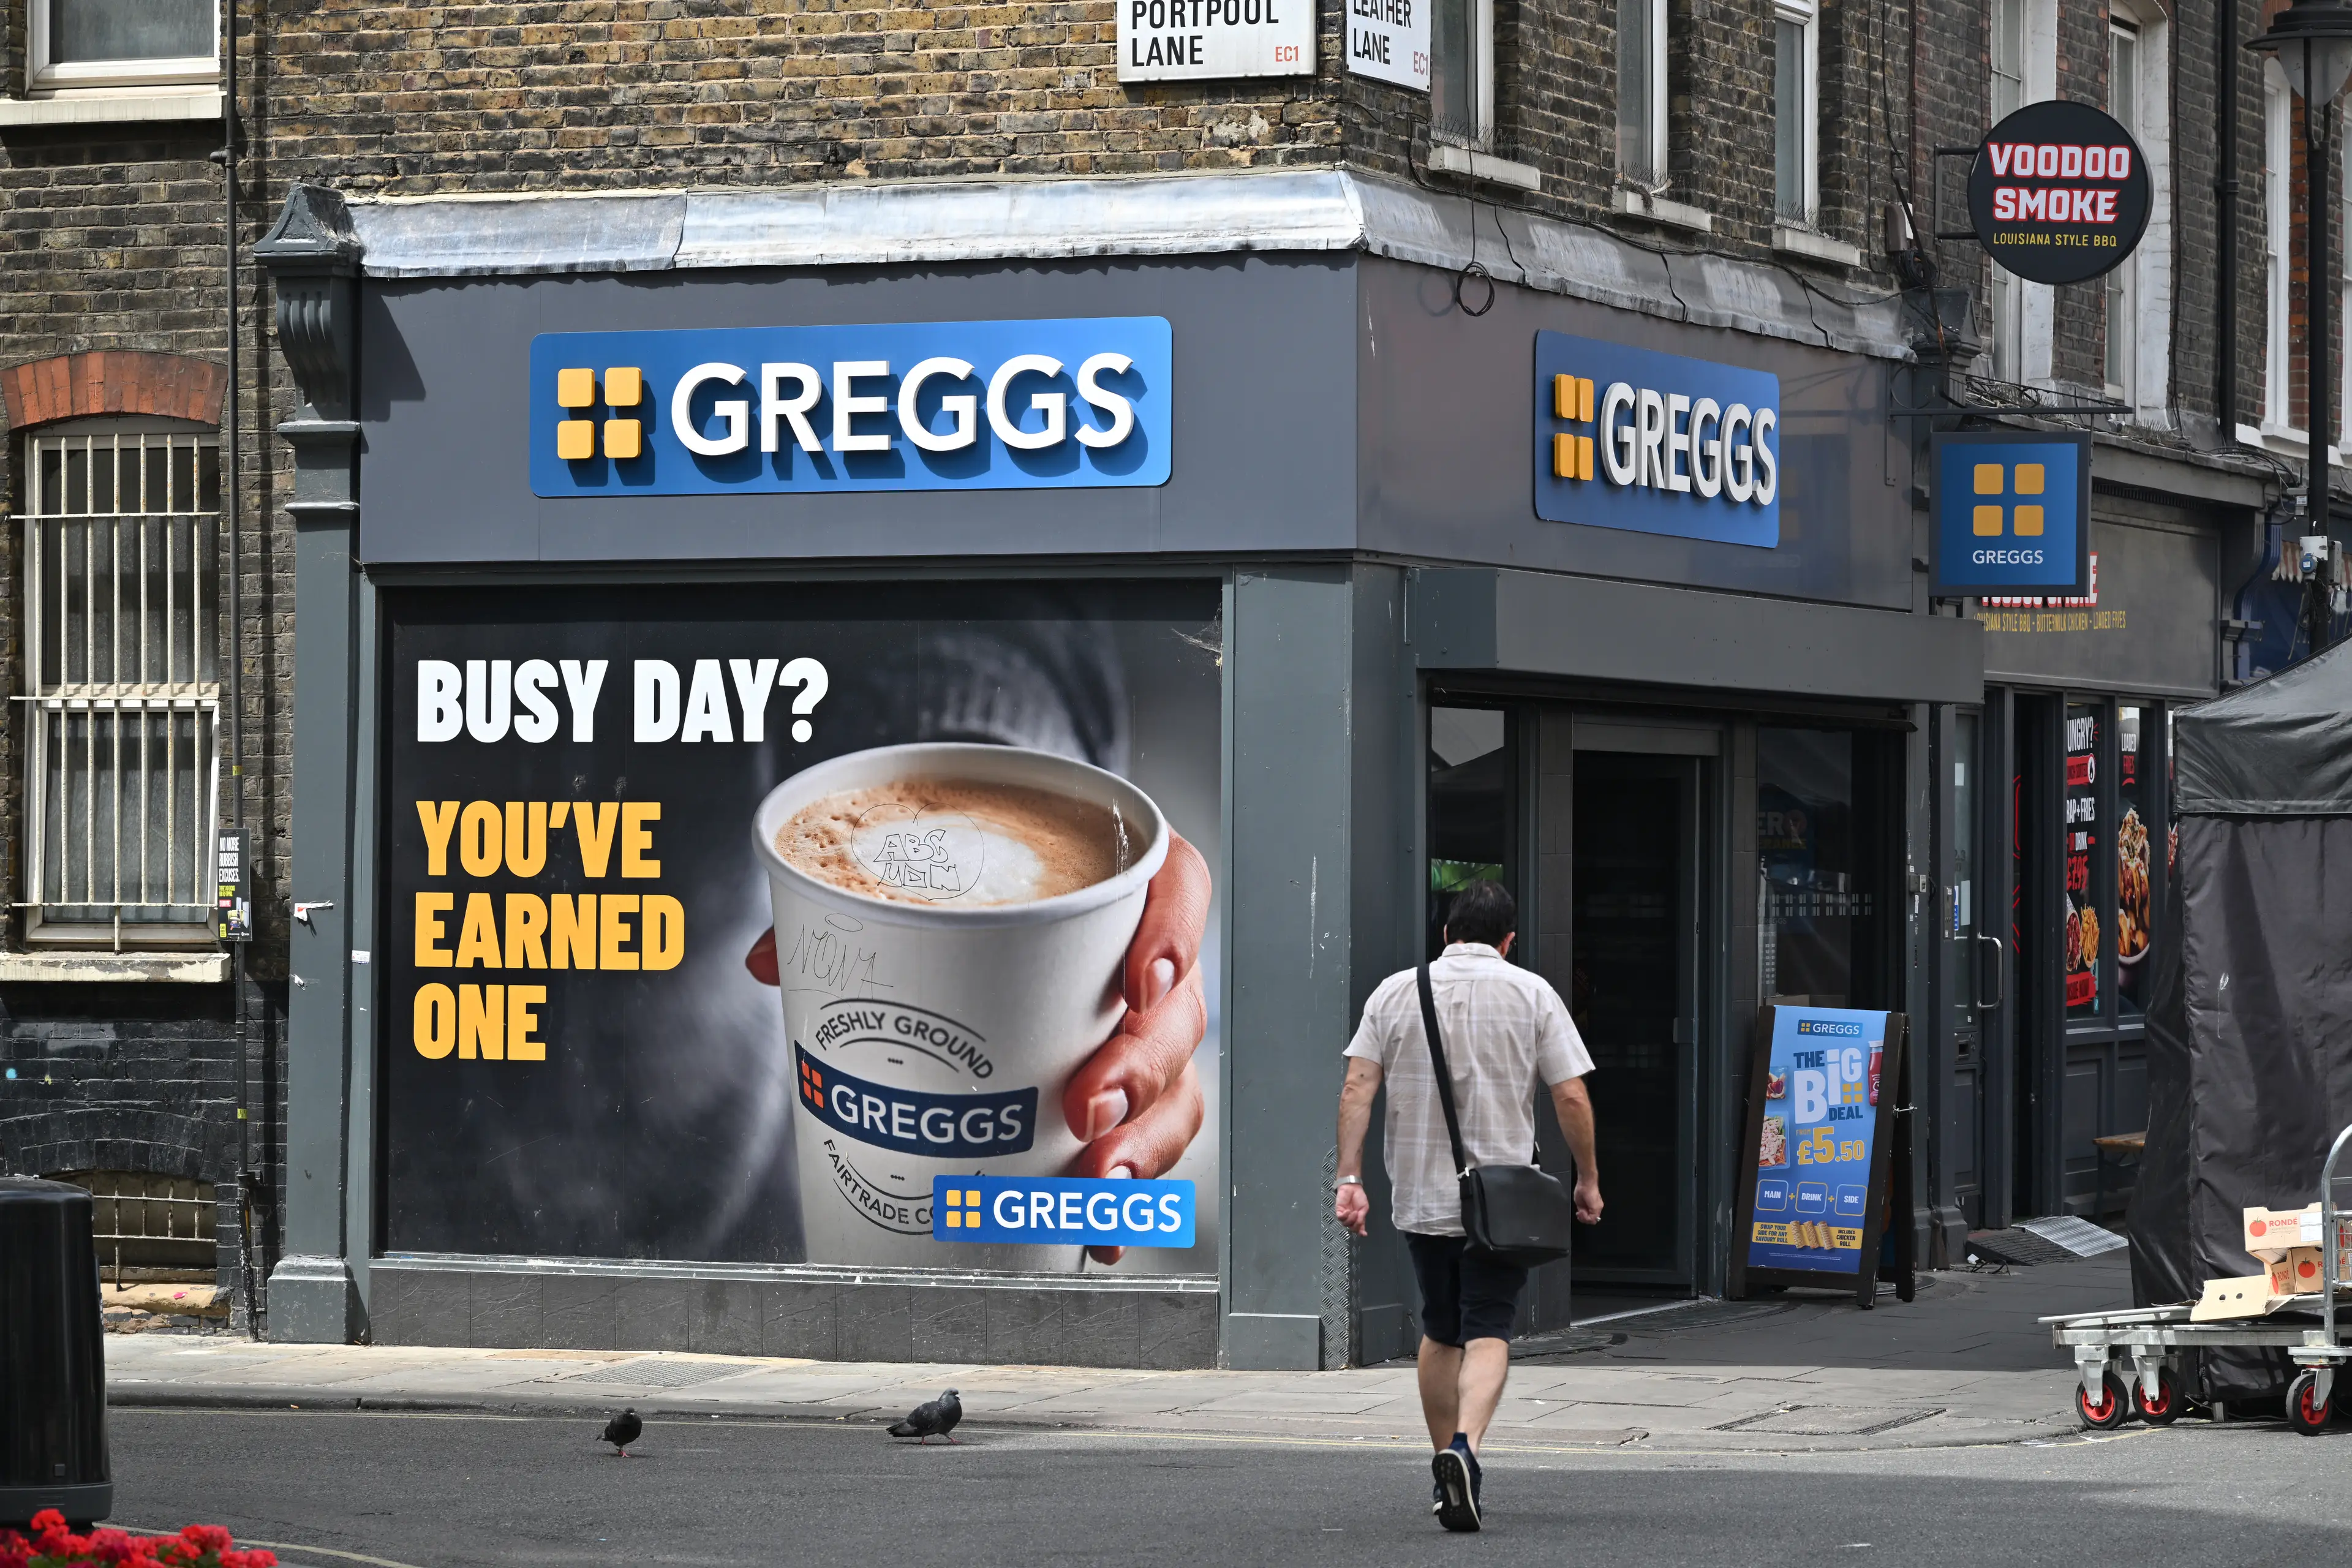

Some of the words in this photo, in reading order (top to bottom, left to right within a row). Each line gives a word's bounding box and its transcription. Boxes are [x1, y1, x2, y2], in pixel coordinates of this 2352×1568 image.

[1131, 0, 1279, 30] PORTPOOL
[1354, 0, 1411, 28] LEATHER
[1131, 35, 1204, 67] LANE
[1275, 45, 1299, 62] EC1
[1354, 28, 1390, 65] LANE
[1414, 51, 1428, 75] EC1
[1987, 142, 2131, 179] VOODOO
[1993, 187, 2120, 223] SMOKE
[1994, 233, 2050, 245] LOUISIANA
[2055, 233, 2089, 246] STYLE
[2094, 235, 2117, 247] BBQ
[671, 353, 1134, 455] GREGGS
[1600, 382, 1776, 505] GREGGS
[1972, 549, 2043, 564] GREGGS
[1974, 612, 2000, 631] SIANA
[2002, 612, 2018, 631] STYLE
[2019, 613, 2030, 632] BBQ
[2037, 613, 2067, 632] BUTTERMILK
[2068, 613, 2088, 631] CHICKEN
[2094, 611, 2111, 629] LOADED
[2113, 611, 2126, 628] FRIES
[417, 659, 609, 743] BUSY
[634, 657, 829, 743] DAY?
[2067, 716, 2094, 752] UNGRY?
[2121, 733, 2136, 752] LOADED
[2067, 799, 2076, 823] RAP
[2081, 797, 2095, 821] FRIES
[219, 837, 226, 851] NO
[226, 837, 239, 851] MORE
[415, 801, 661, 878] YOU'VE
[219, 853, 238, 867] RUBBISH
[219, 868, 240, 882] EXCUSES.
[415, 892, 685, 971] EARNED
[413, 983, 546, 1061] ONE
[1812, 1023, 1860, 1035] GREGGS
[815, 1011, 886, 1050] FRESHLY
[894, 1015, 994, 1079] GROUND
[1793, 1050, 1825, 1069] THE
[831, 1084, 1022, 1144] GREGGS
[1828, 1106, 1863, 1121] DEAL
[824, 1139, 909, 1226] FAIRTRADE
[993, 1190, 1182, 1232] GREGGS
[1801, 1193, 1822, 1201] DRINK
[2269, 1217, 2297, 1227] RONDÉ
[2277, 1268, 2290, 1282] RONDÉ
